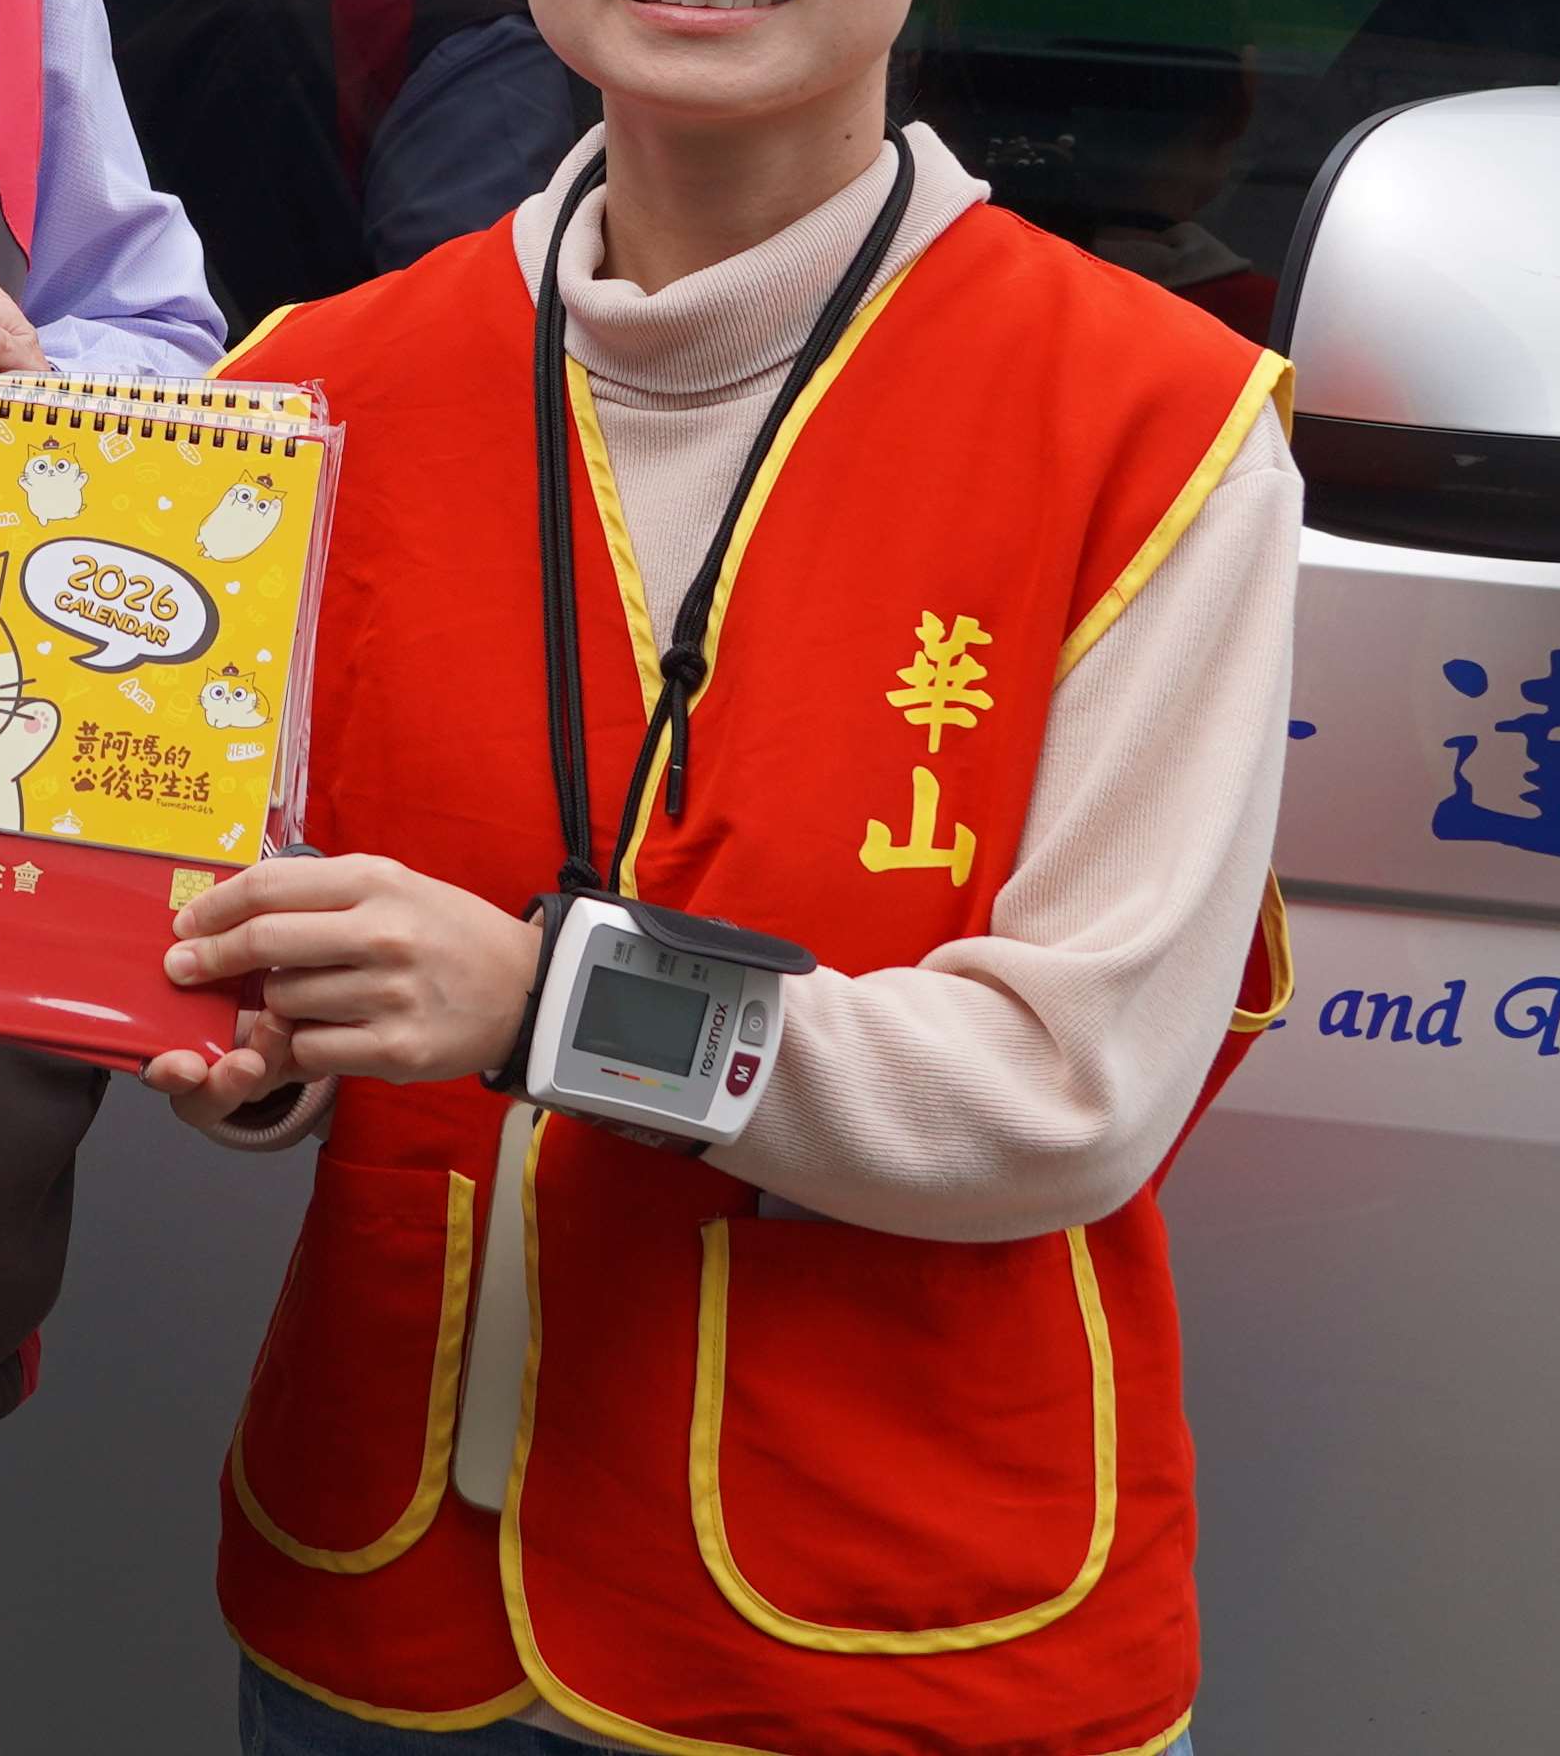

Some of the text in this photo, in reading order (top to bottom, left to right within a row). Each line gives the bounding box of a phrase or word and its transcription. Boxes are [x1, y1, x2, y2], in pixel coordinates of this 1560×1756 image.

[67, 554, 179, 621] 2026
[54, 591, 171, 648] CALENDAR
[118, 677, 156, 714] Ama
[72, 720, 192, 770] 黃阿瑪的
[859, 610, 994, 887] 華山
[99, 764, 212, 803] 後宮生活
[699, 1002, 729, 1079] rossmax
[1318, 979, 1466, 1047] and
[734, 1064, 750, 1083] M
